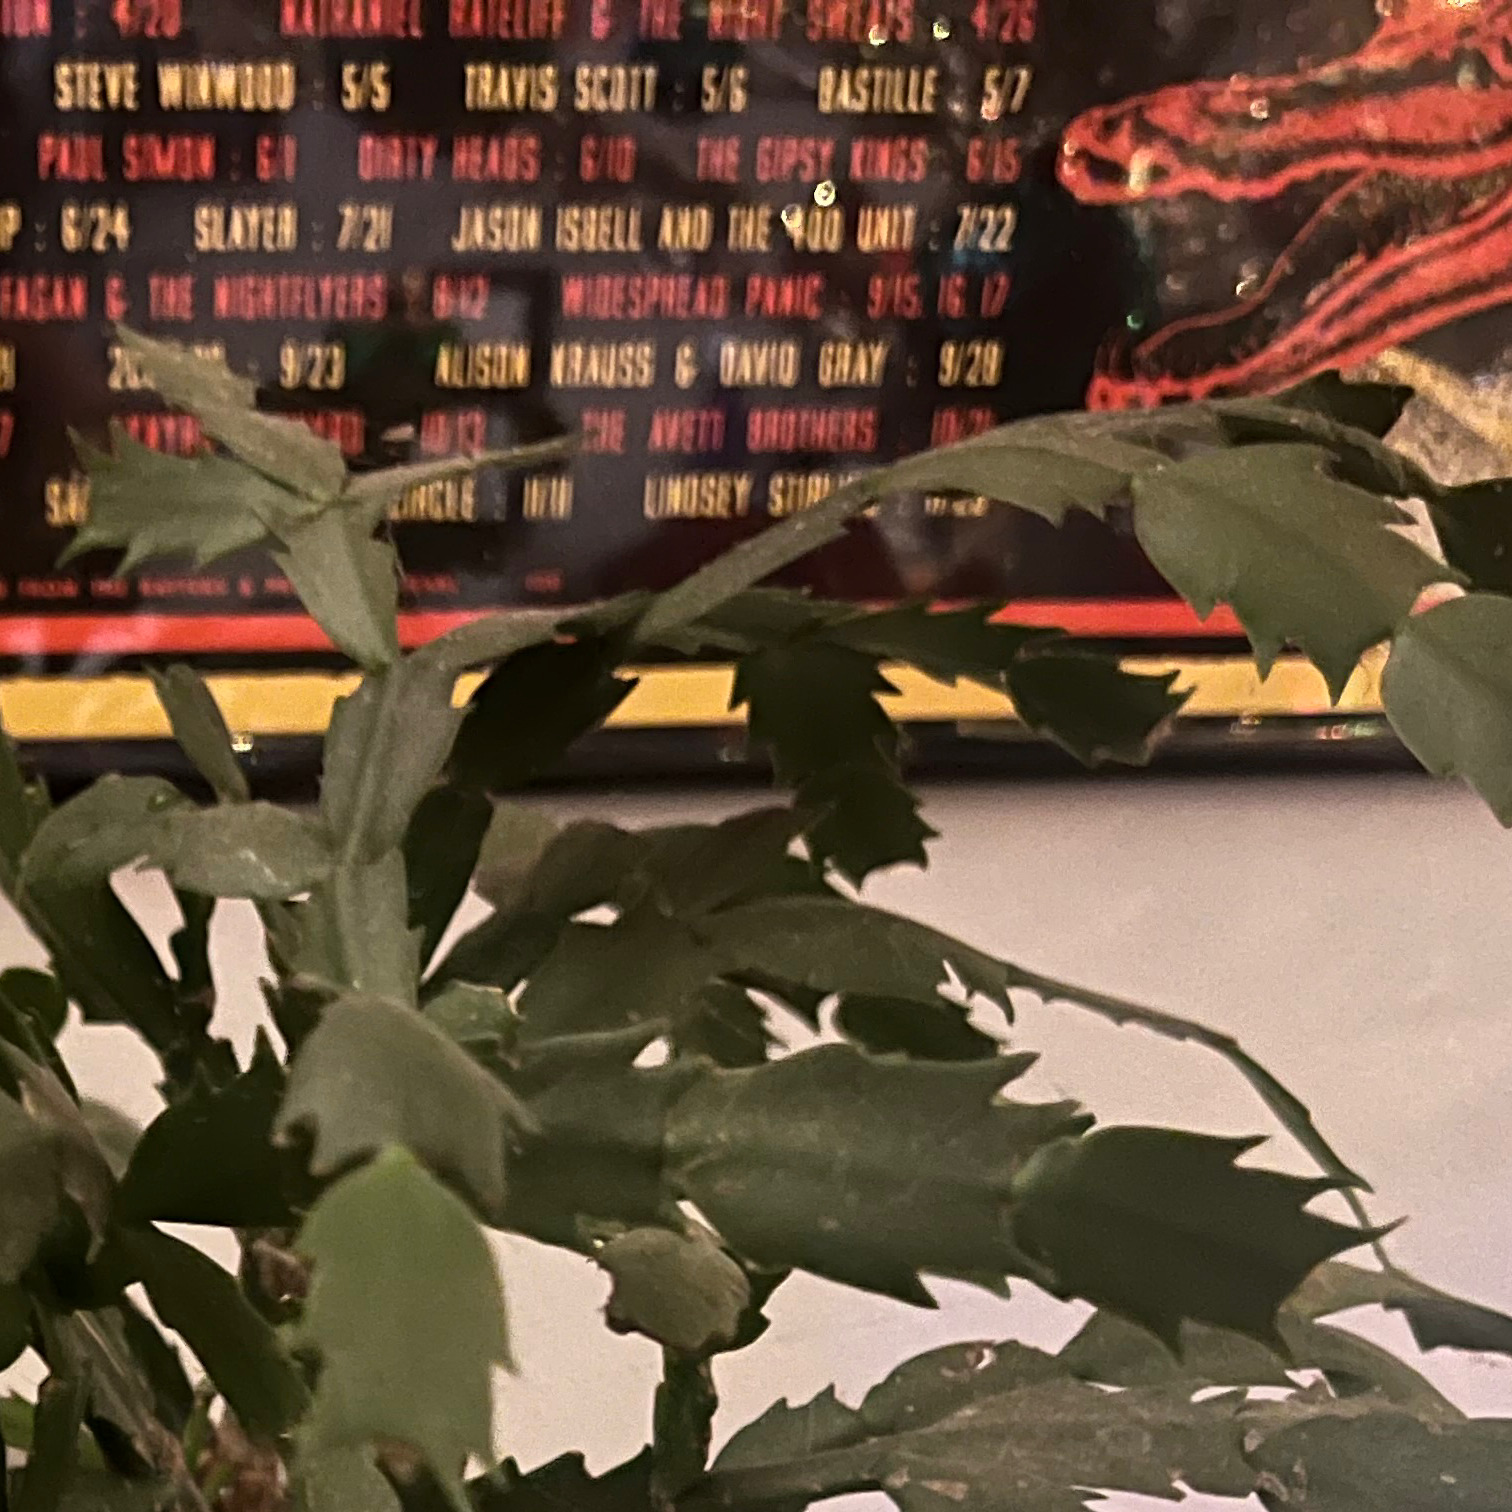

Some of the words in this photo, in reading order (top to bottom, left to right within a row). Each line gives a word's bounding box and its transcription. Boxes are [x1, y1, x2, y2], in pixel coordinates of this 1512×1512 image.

[53, 61, 138, 111] STEVE
[157, 61, 296, 111] WINWOOD
[341, 61, 390, 112] 5/5
[464, 63, 558, 112] TRAVIS
[574, 63, 658, 112] SCOTT
[701, 64, 748, 112] 5/6
[818, 64, 937, 113] BASTILLE
[981, 64, 1033, 115] 5/7
[38, 133, 106, 181] PAUL
[122, 133, 215, 181] SIMON
[696, 135, 740, 182] THE
[849, 135, 928, 182] KINGS
[61, 202, 130, 251] 6/24
[194, 202, 297, 251] SLAYER
[451, 203, 541, 251] JASON
[555, 203, 641, 251] ISBELL
[658, 203, 714, 251] AND
[728, 203, 773, 251] THE
[857, 204, 917, 251] UNIT
[954, 204, 1017, 251] 7/22
[104, 272, 129, 322] &
[148, 274, 194, 322] THE
[561, 273, 730, 320] WIDESPREAD
[745, 272, 826, 320] PANIC
[434, 340, 532, 389] ALISON
[550, 340, 656, 389] KRAUSS
[674, 339, 699, 389] &
[719, 339, 801, 389] DAVID
[819, 339, 890, 388] GRAY
[745, 407, 878, 452] BROTHERS
[644, 471, 753, 520] LINDSEY
